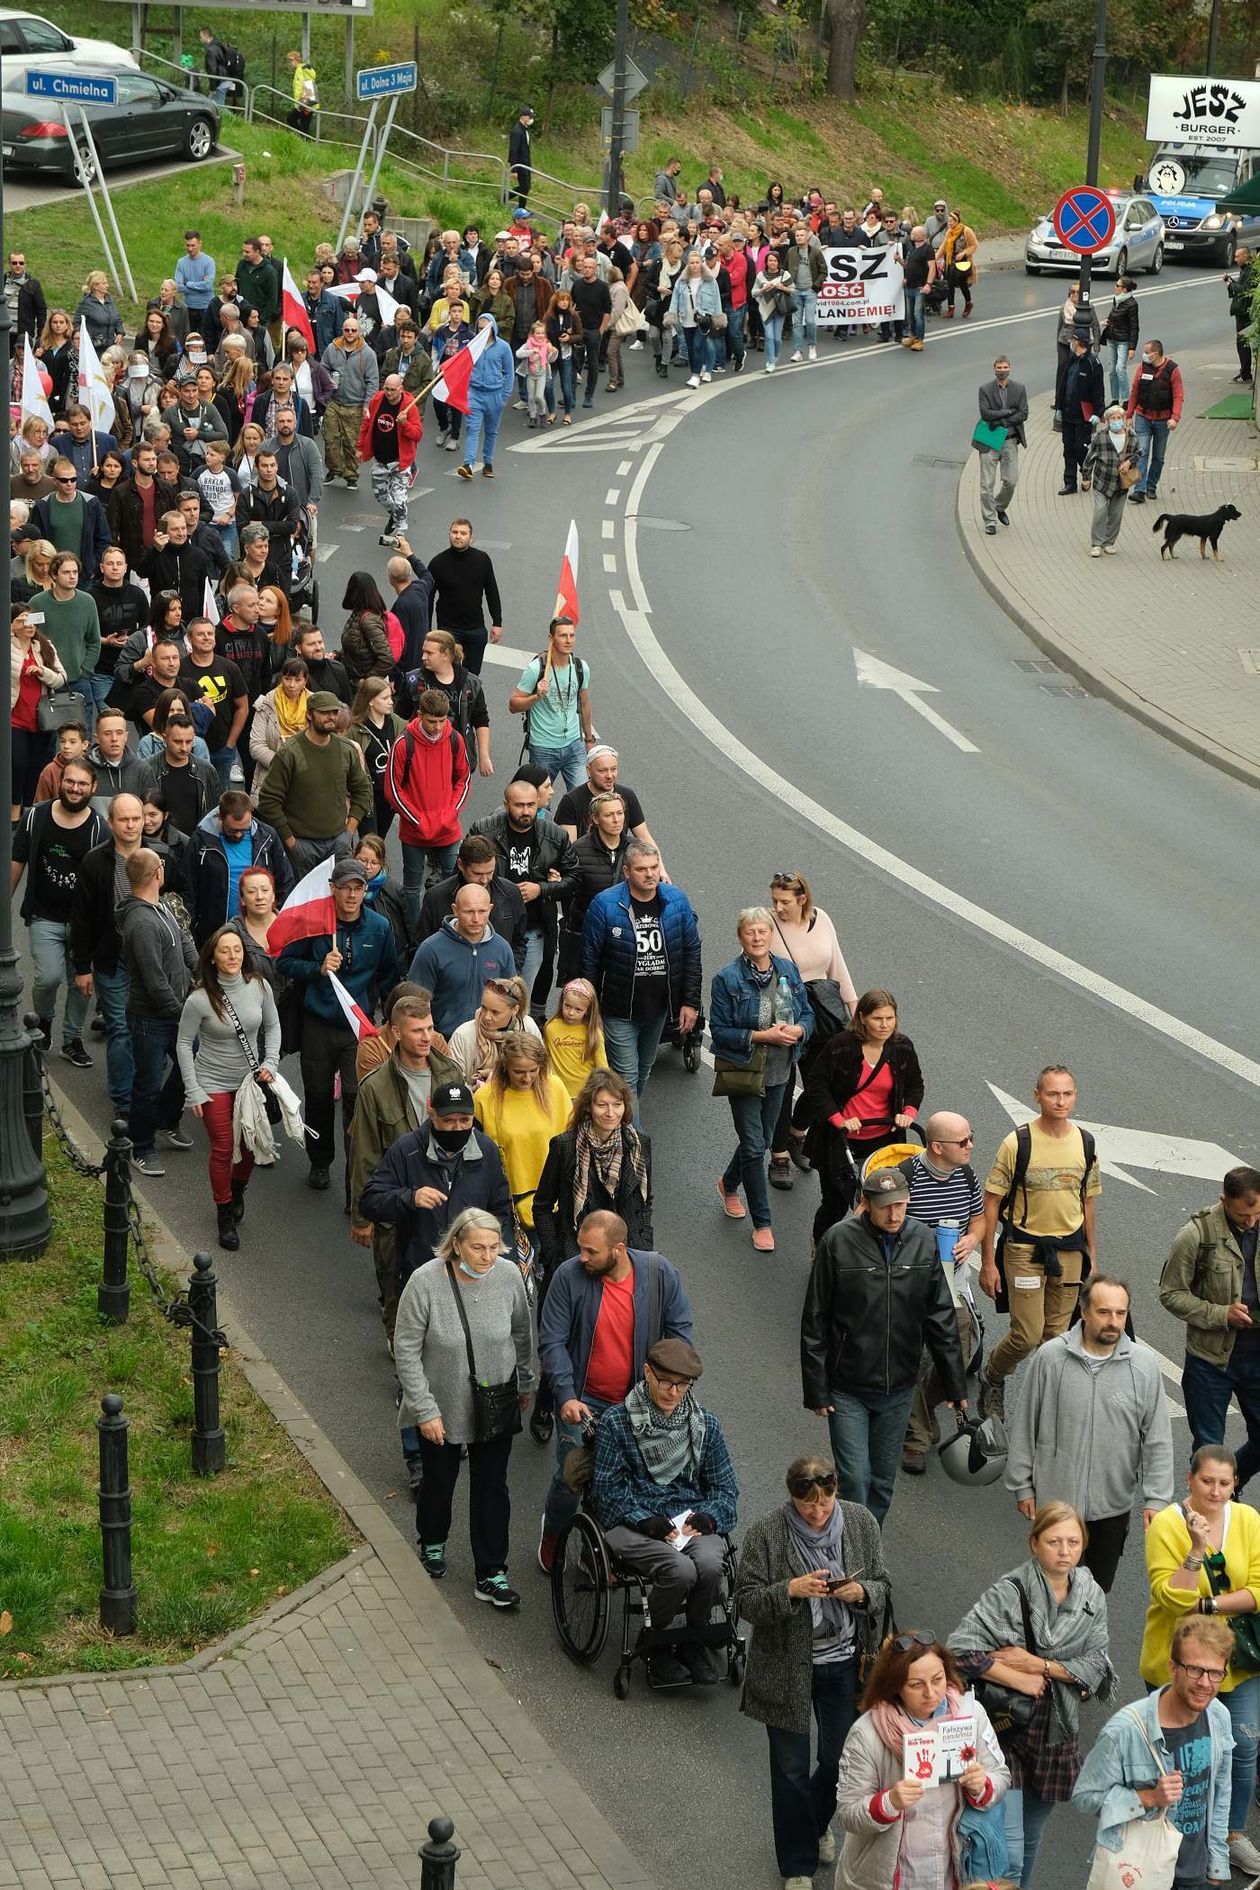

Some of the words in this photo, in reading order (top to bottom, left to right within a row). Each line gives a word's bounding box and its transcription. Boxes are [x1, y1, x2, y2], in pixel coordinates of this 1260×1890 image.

[32, 78, 46, 91] ul.
[53, 79, 108, 97] Chmielna
[371, 76, 389, 90] Dolna
[390, 73, 396, 86] 3
[396, 71, 412, 86] Maja
[1172, 83, 1247, 124] JESZ
[1180, 123, 1236, 135] BURGER
[1206, 135, 1226, 143] 2007
[815, 304, 896, 318] LANDEMIĘ!
[636, 929, 663, 953] 50
